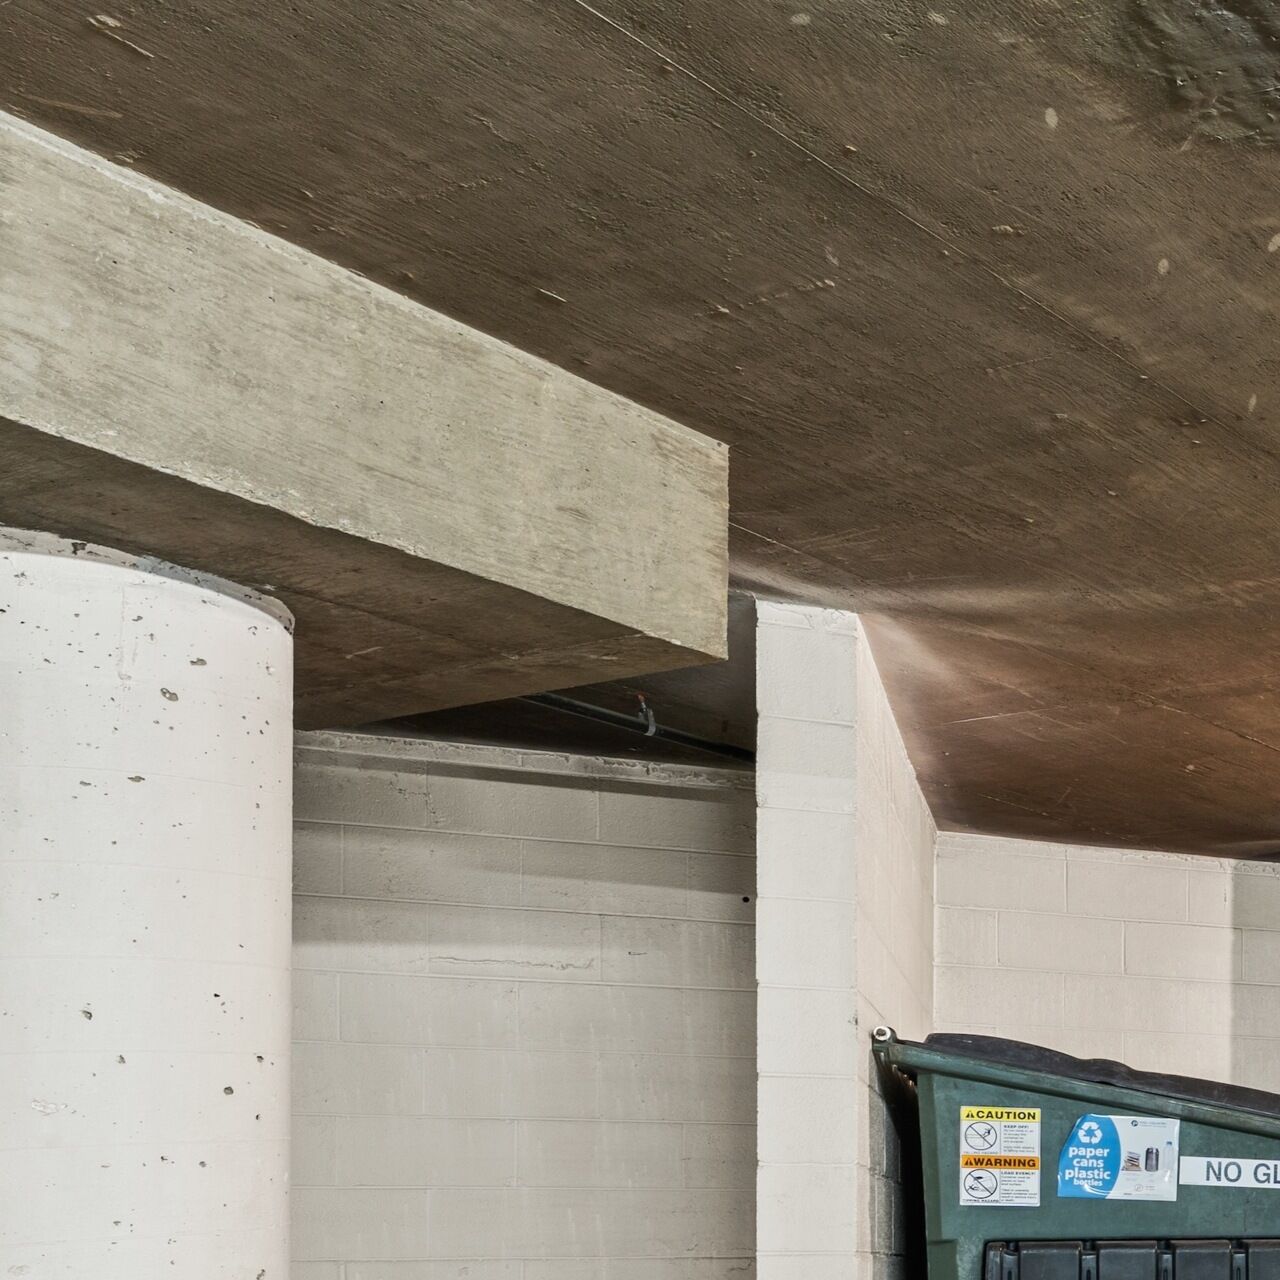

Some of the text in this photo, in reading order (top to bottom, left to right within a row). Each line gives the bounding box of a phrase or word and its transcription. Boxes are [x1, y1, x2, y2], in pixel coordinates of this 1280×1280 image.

[976, 1110, 1036, 1120] CAUTION
[1068, 1147, 1110, 1158] paper
[973, 1157, 1036, 1168] WARNING
[1073, 1158, 1104, 1167] cans
[1065, 1168, 1111, 1180] plastic
[1205, 1160, 1242, 1183] NO
[1073, 1179, 1103, 1187] bottles
